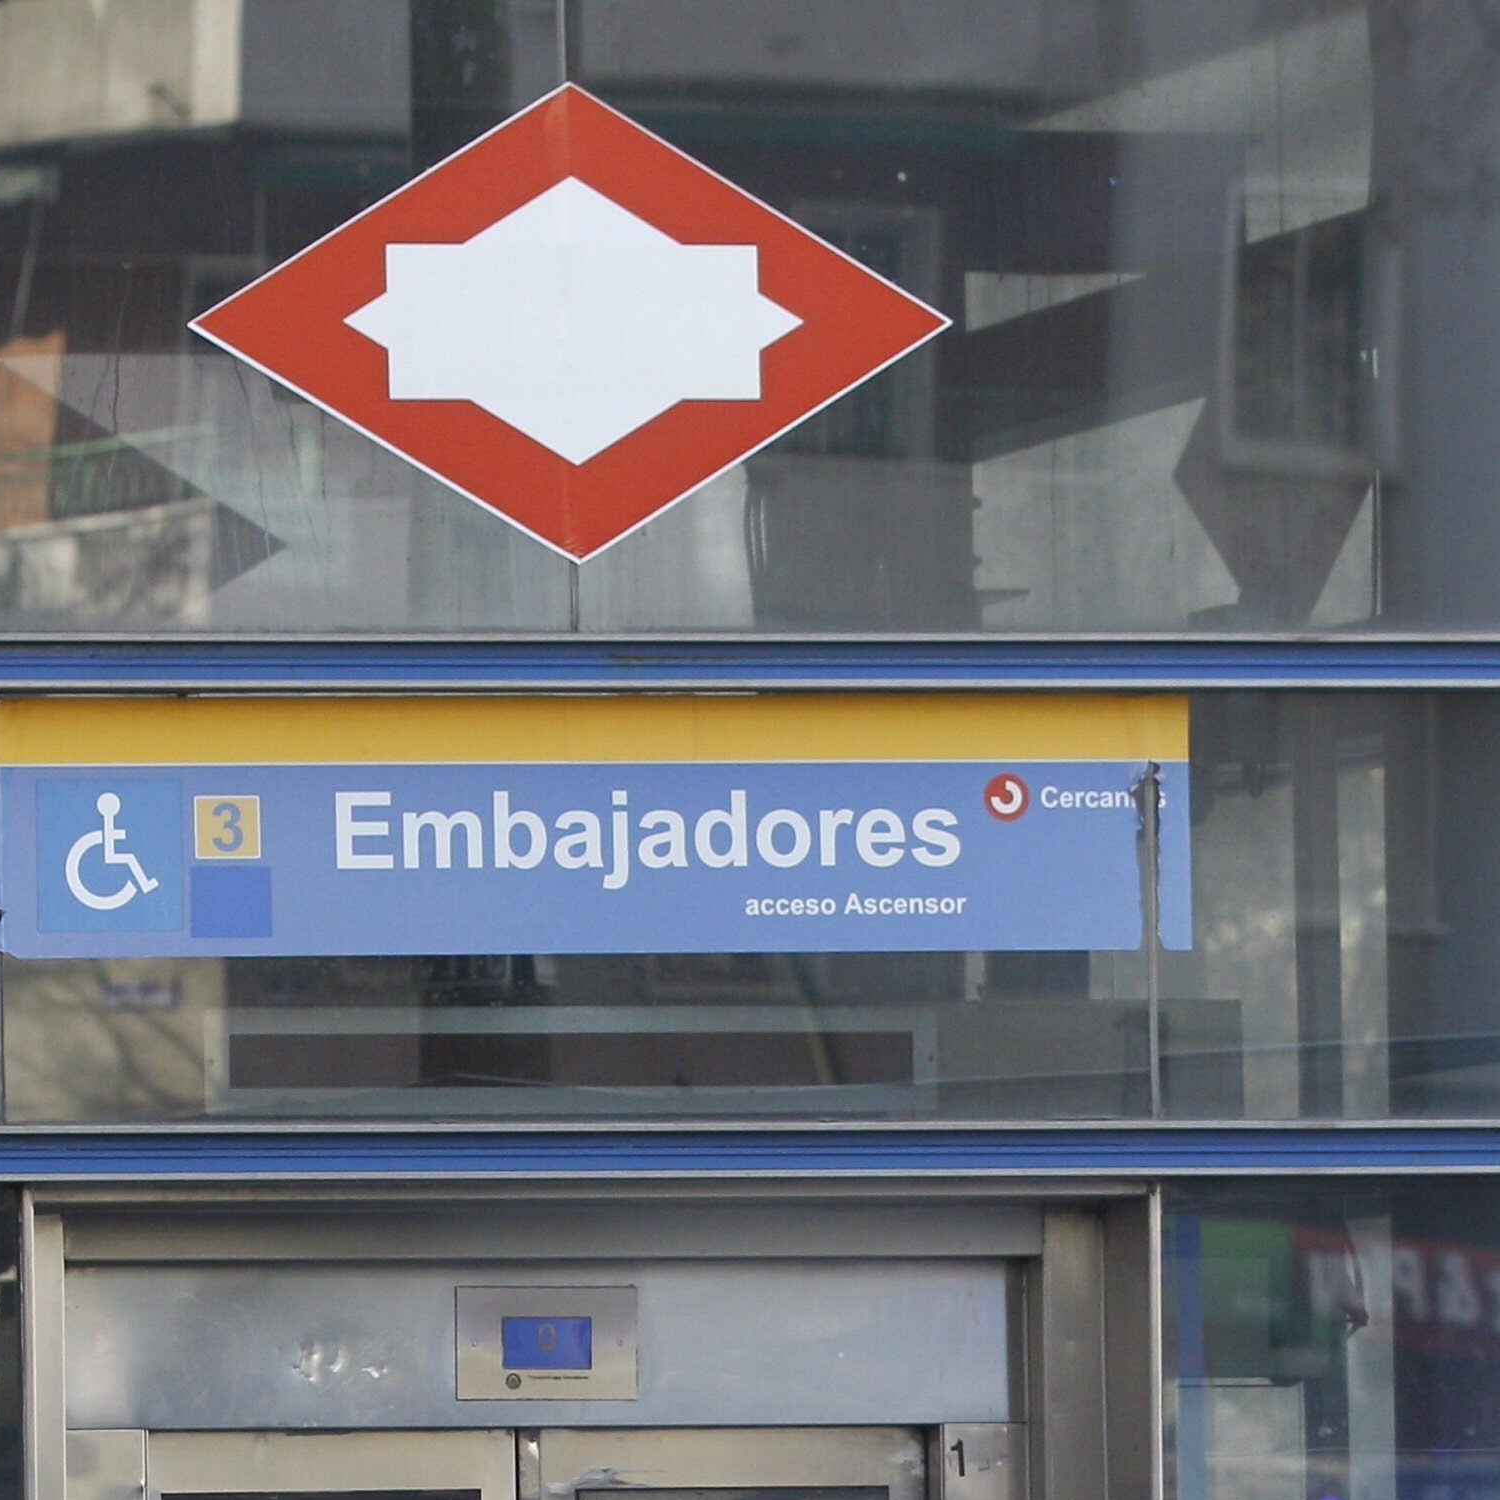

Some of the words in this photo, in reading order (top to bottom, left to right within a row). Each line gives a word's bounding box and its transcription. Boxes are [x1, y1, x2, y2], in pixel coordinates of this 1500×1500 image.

[1040, 785, 1167, 809] Cercans
[211, 802, 242, 852] 3
[334, 789, 963, 890] Embajadores
[744, 894, 836, 917] acceso
[844, 892, 967, 917] Ascensor
[950, 1438, 966, 1477] 1
